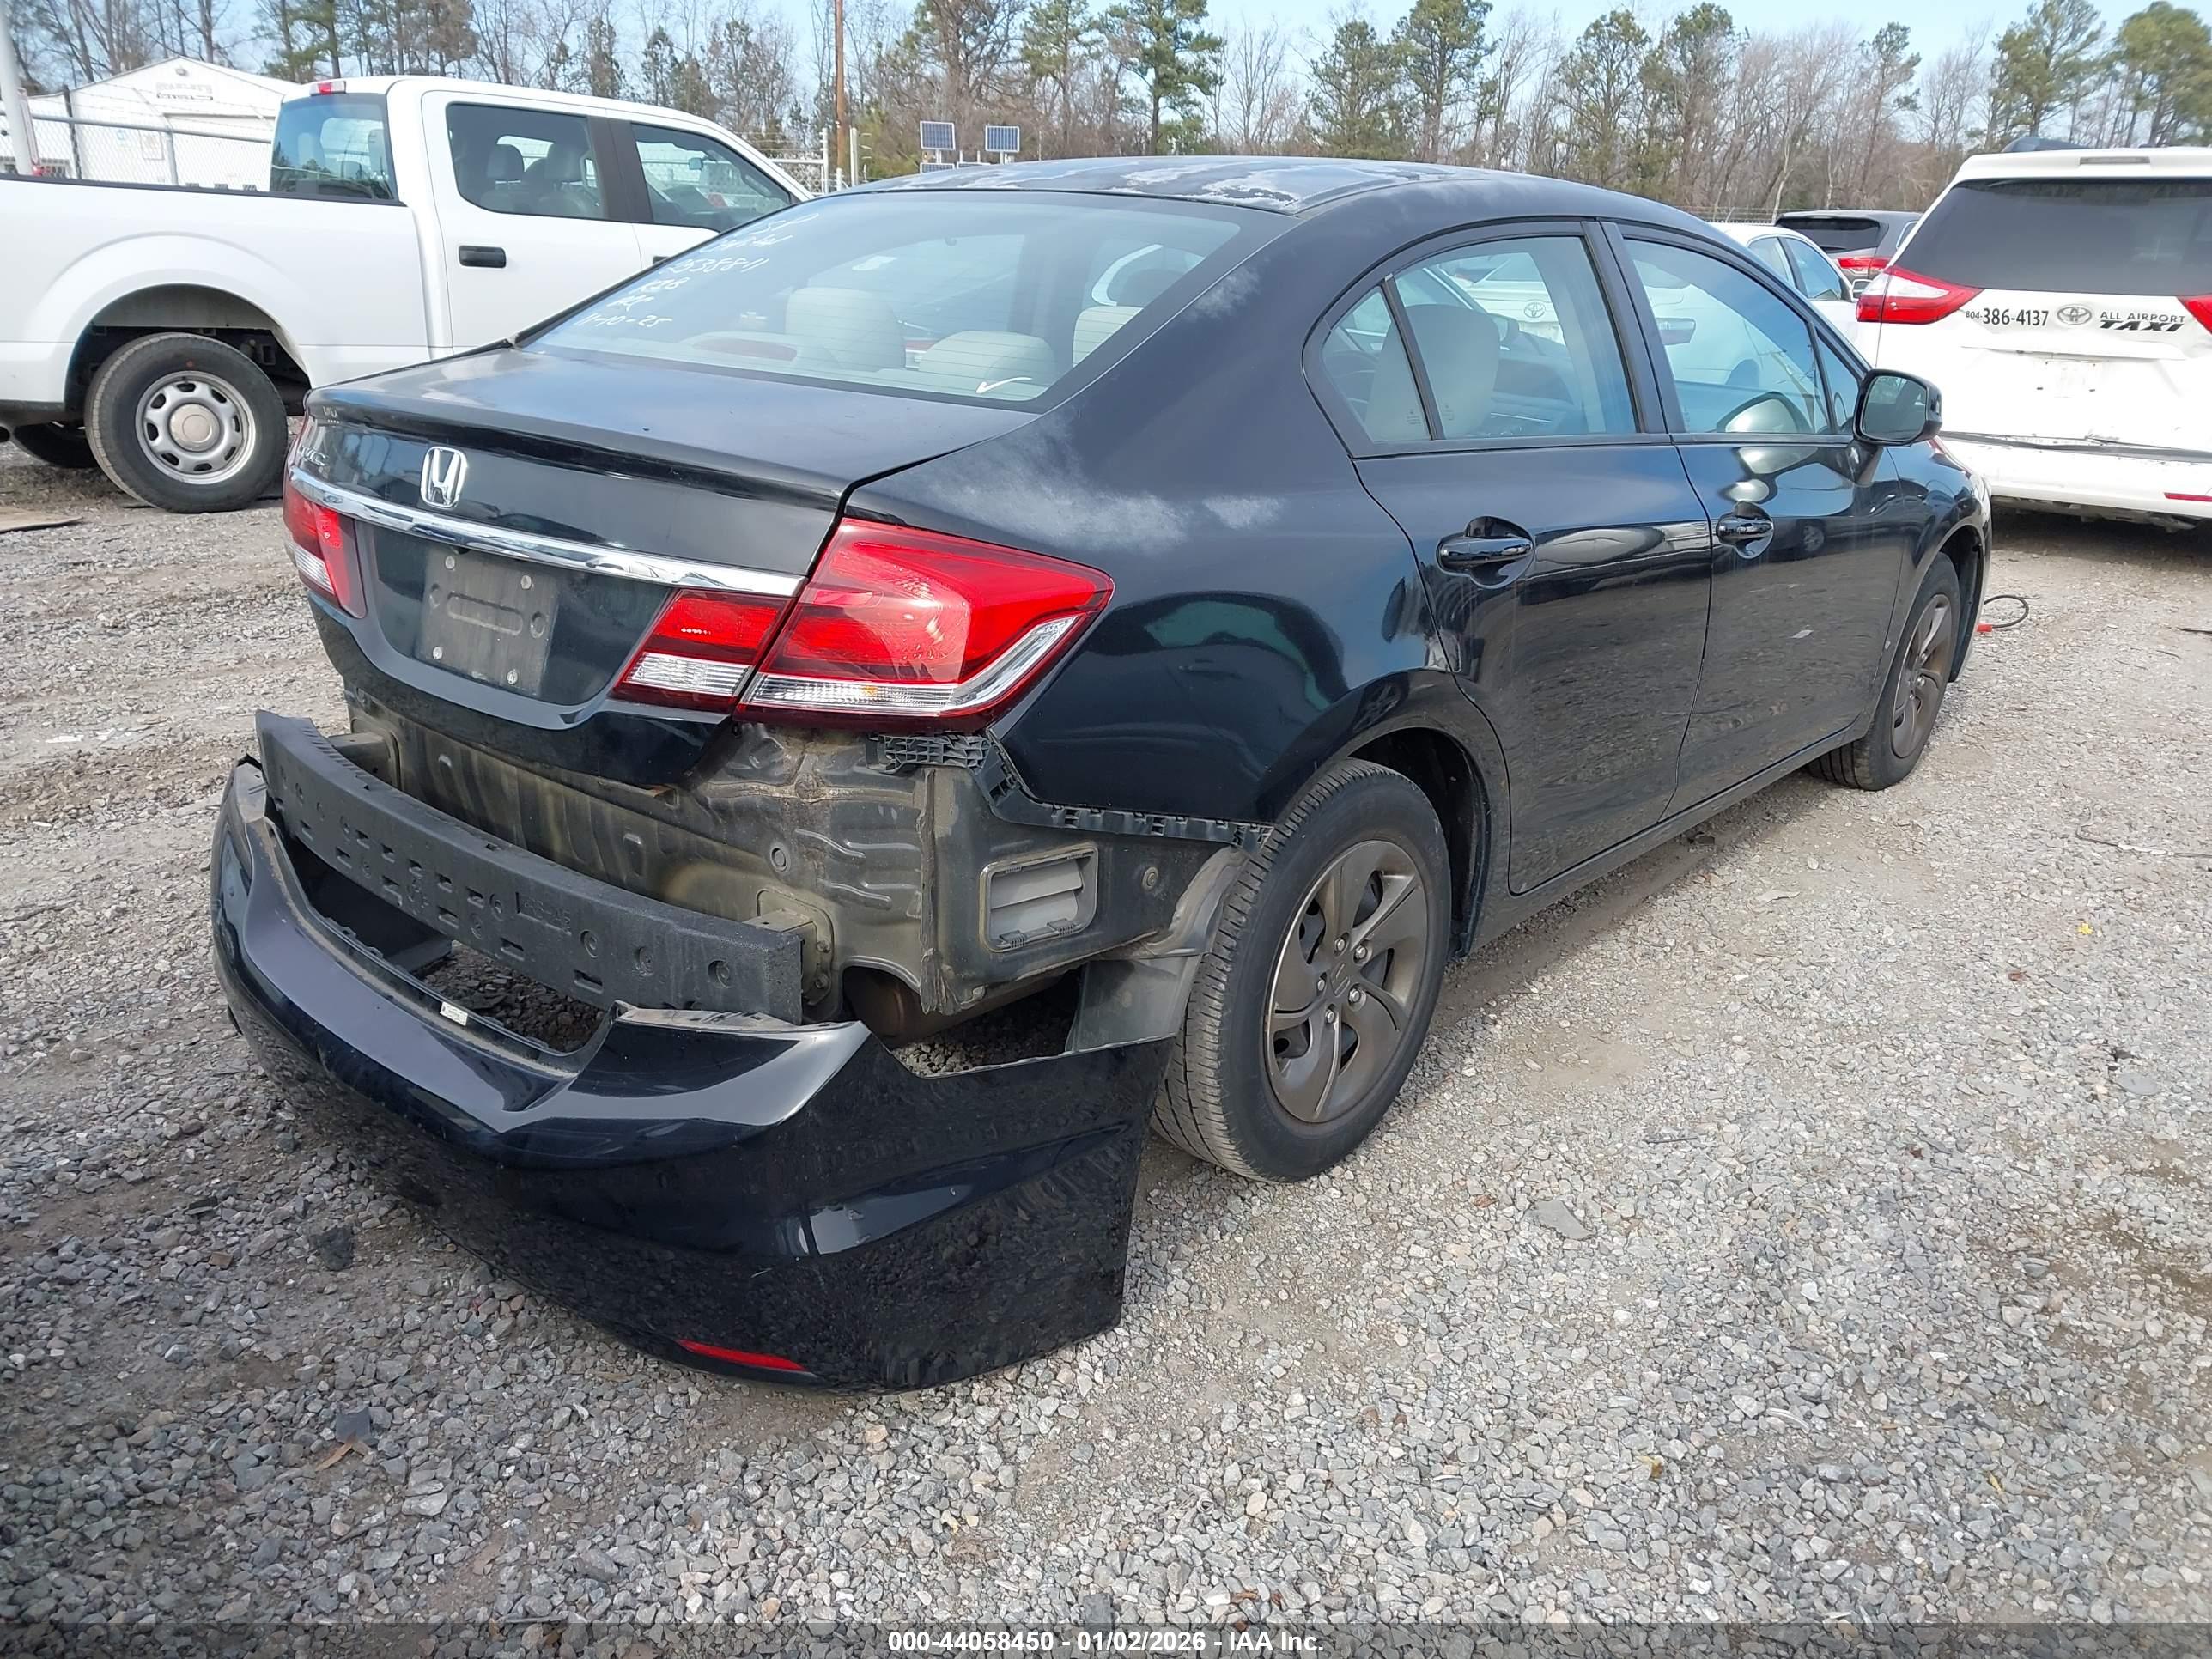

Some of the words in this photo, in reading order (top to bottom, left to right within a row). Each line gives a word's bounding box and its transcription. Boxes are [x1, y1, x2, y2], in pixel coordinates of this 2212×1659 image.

[1966, 308, 2049, 326] 804-386-4137
[2127, 313, 2185, 323] AIRPORT
[2100, 320, 2184, 332] TAXI
